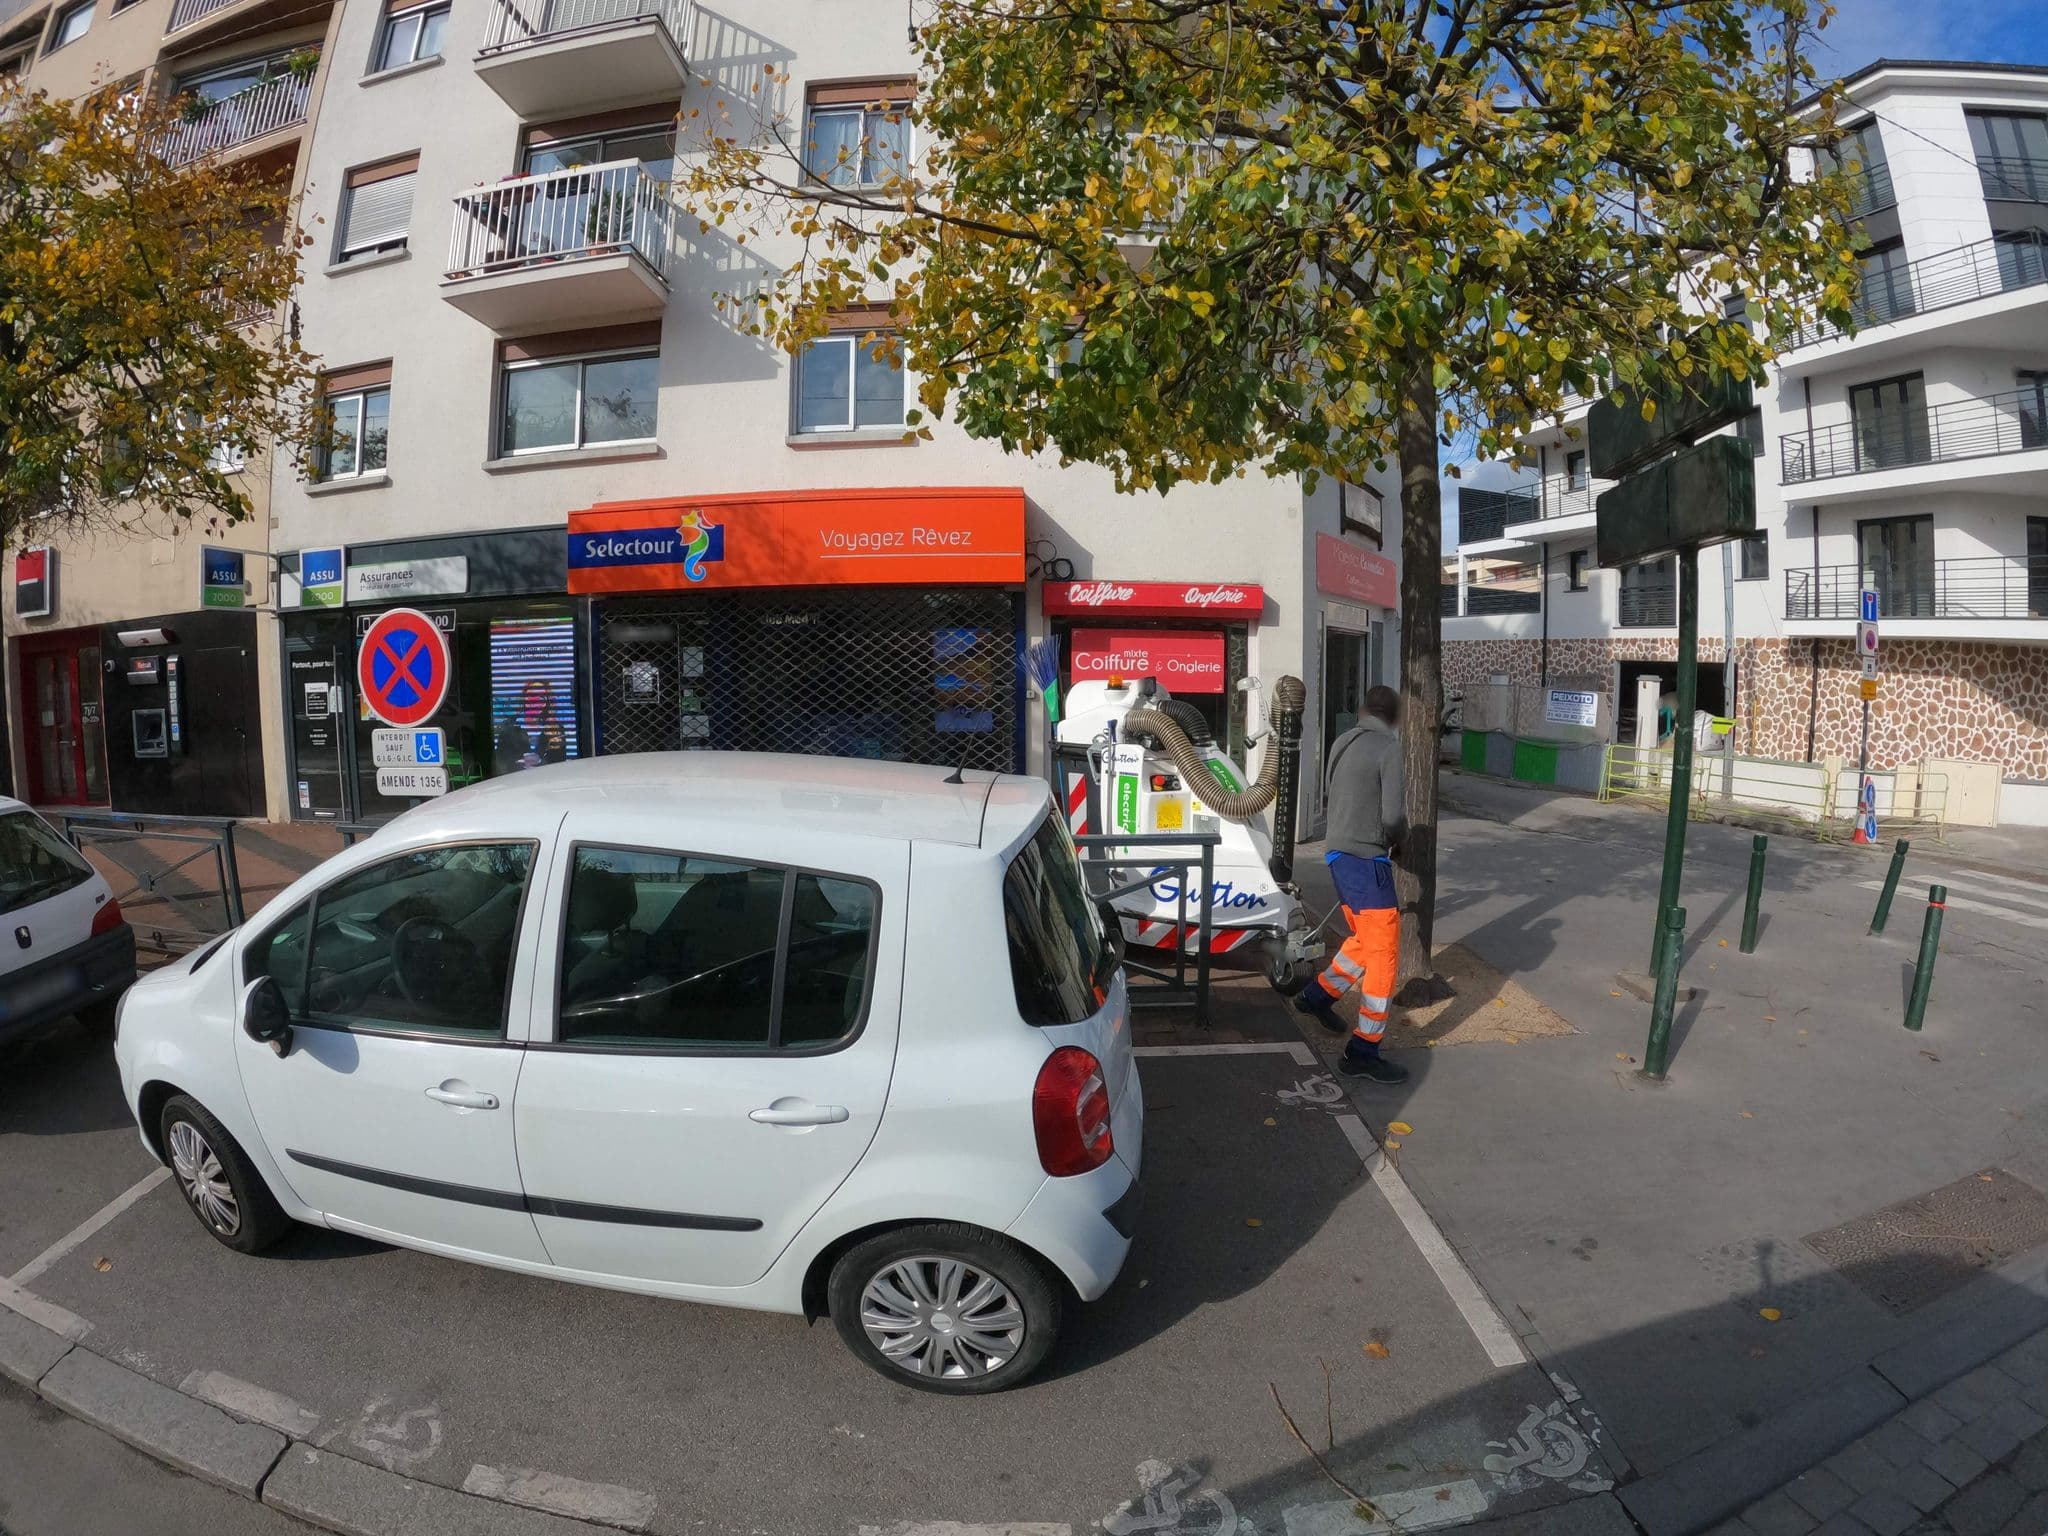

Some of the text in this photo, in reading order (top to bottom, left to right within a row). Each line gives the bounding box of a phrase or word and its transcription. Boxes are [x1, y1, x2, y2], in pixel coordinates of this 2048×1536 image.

[819, 527, 972, 551] Voyagez Rêvez
[585, 538, 675, 559] Selectour
[211, 569, 237, 582] ASSU
[310, 569, 335, 582] ASSU
[359, 570, 414, 584] Assurances
[212, 592, 237, 602] 2000
[1068, 581, 1244, 608] Coiffure Onglerie
[1123, 649, 1149, 658] mixte
[1075, 652, 1149, 671] Coiffure
[1167, 659, 1222, 674] Onglerie
[1552, 692, 1593, 703] PEIXOTO
[377, 733, 411, 742] INTERDIT
[385, 744, 404, 752] SAUF
[381, 775, 443, 788] AMENDE 135€
[1122, 782, 1132, 830] electric
